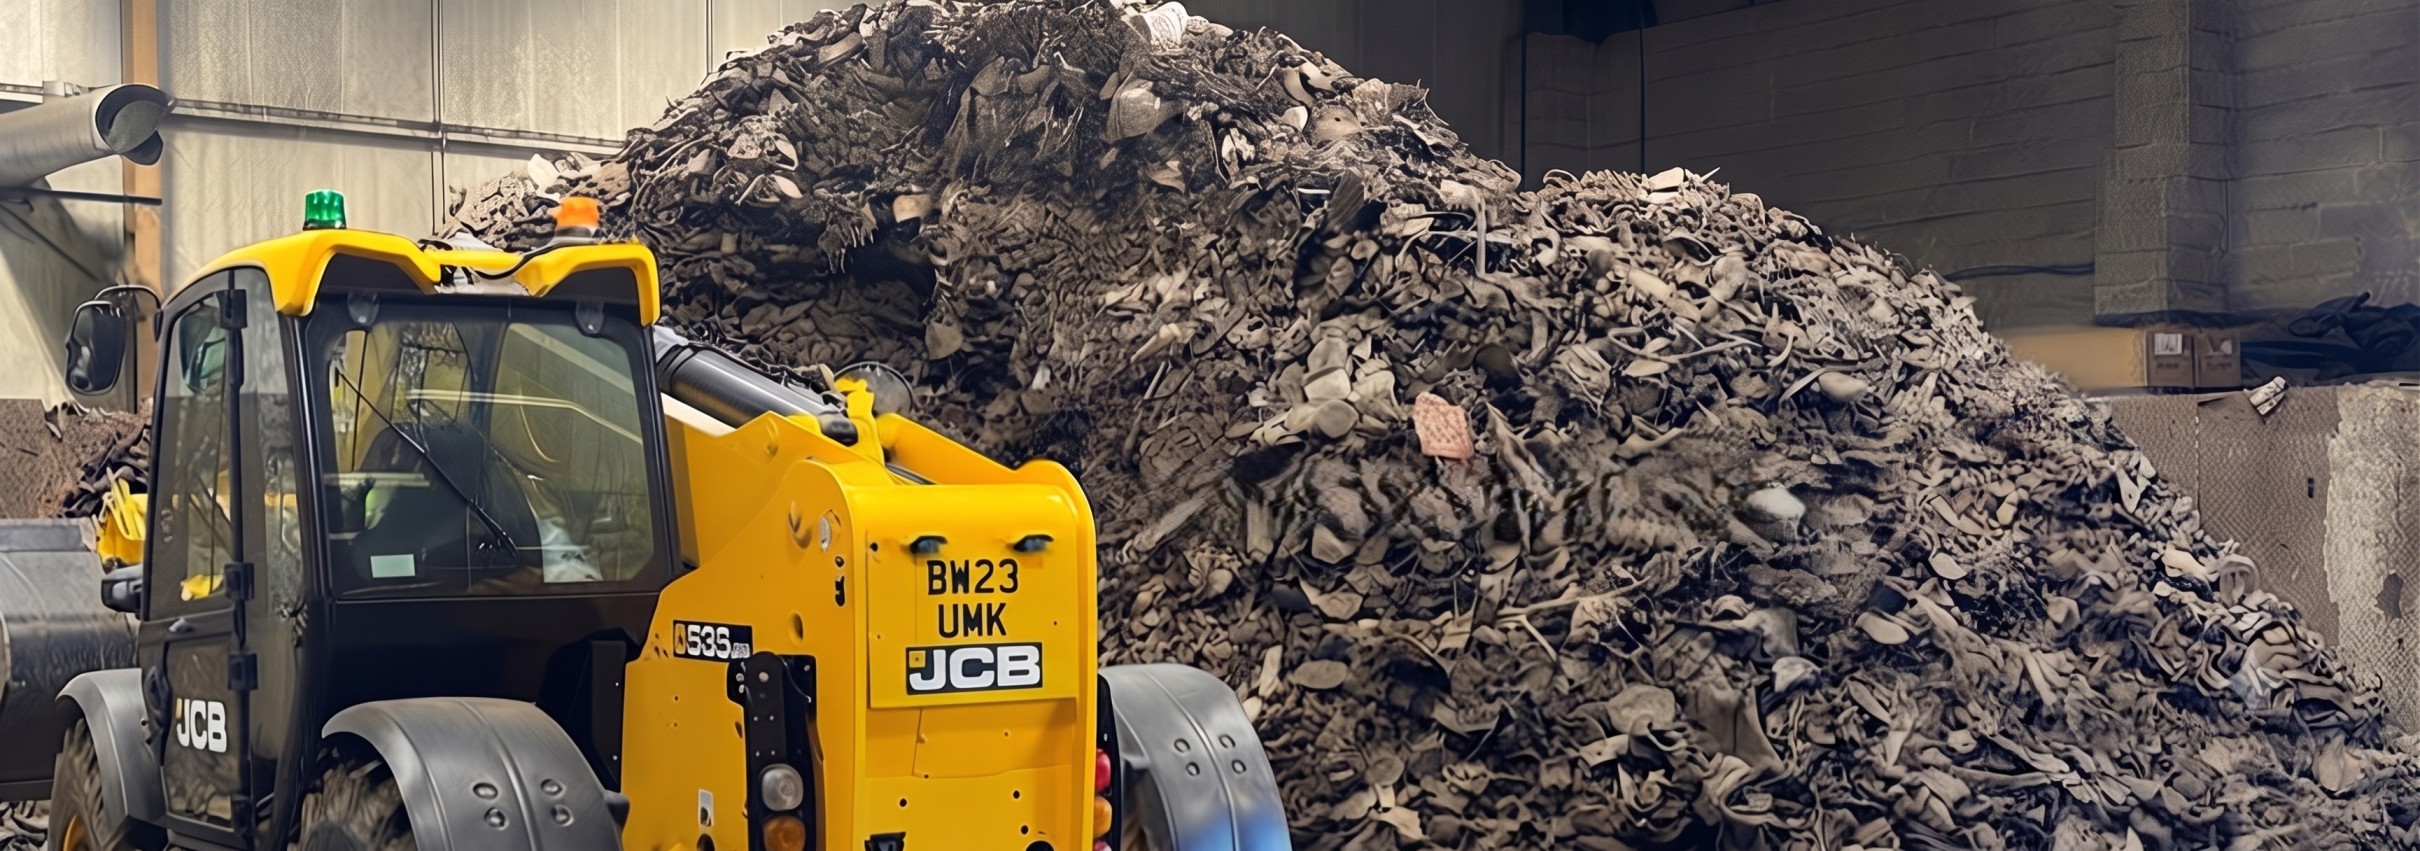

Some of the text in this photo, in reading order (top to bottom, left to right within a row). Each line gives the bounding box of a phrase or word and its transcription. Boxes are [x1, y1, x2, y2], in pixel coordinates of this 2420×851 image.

[926, 558, 1019, 595] BW23
[937, 602, 1007, 639] UMK
[908, 645, 1041, 691] JCB
[176, 698, 228, 753] JCB
